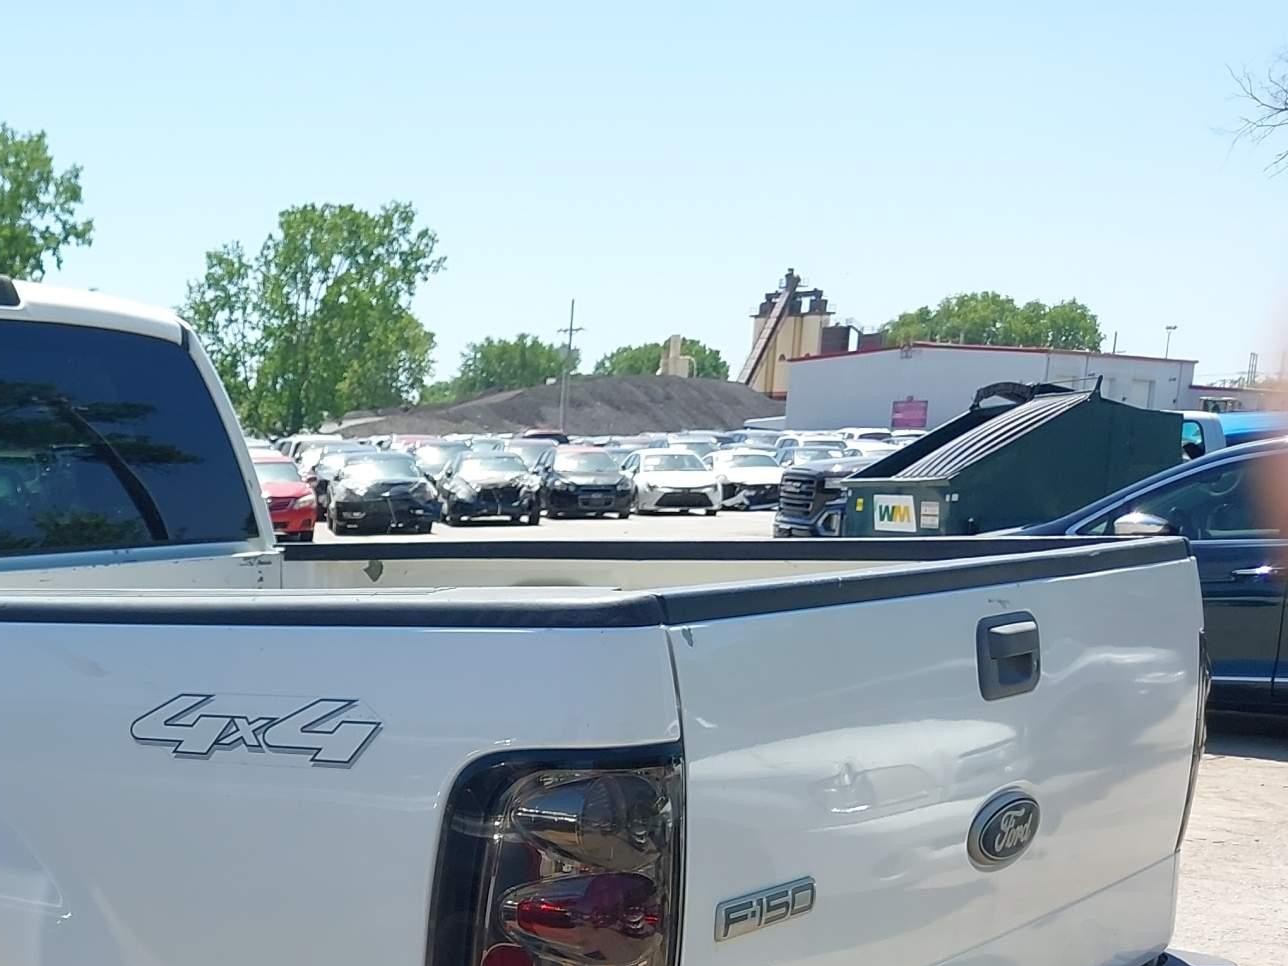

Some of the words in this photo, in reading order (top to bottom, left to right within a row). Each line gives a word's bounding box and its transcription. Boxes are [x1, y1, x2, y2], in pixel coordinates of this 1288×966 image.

[878, 504, 912, 523] WM
[130, 693, 383, 768] 4x4
[994, 807, 1033, 853] Ford
[722, 882, 817, 937] F-150
